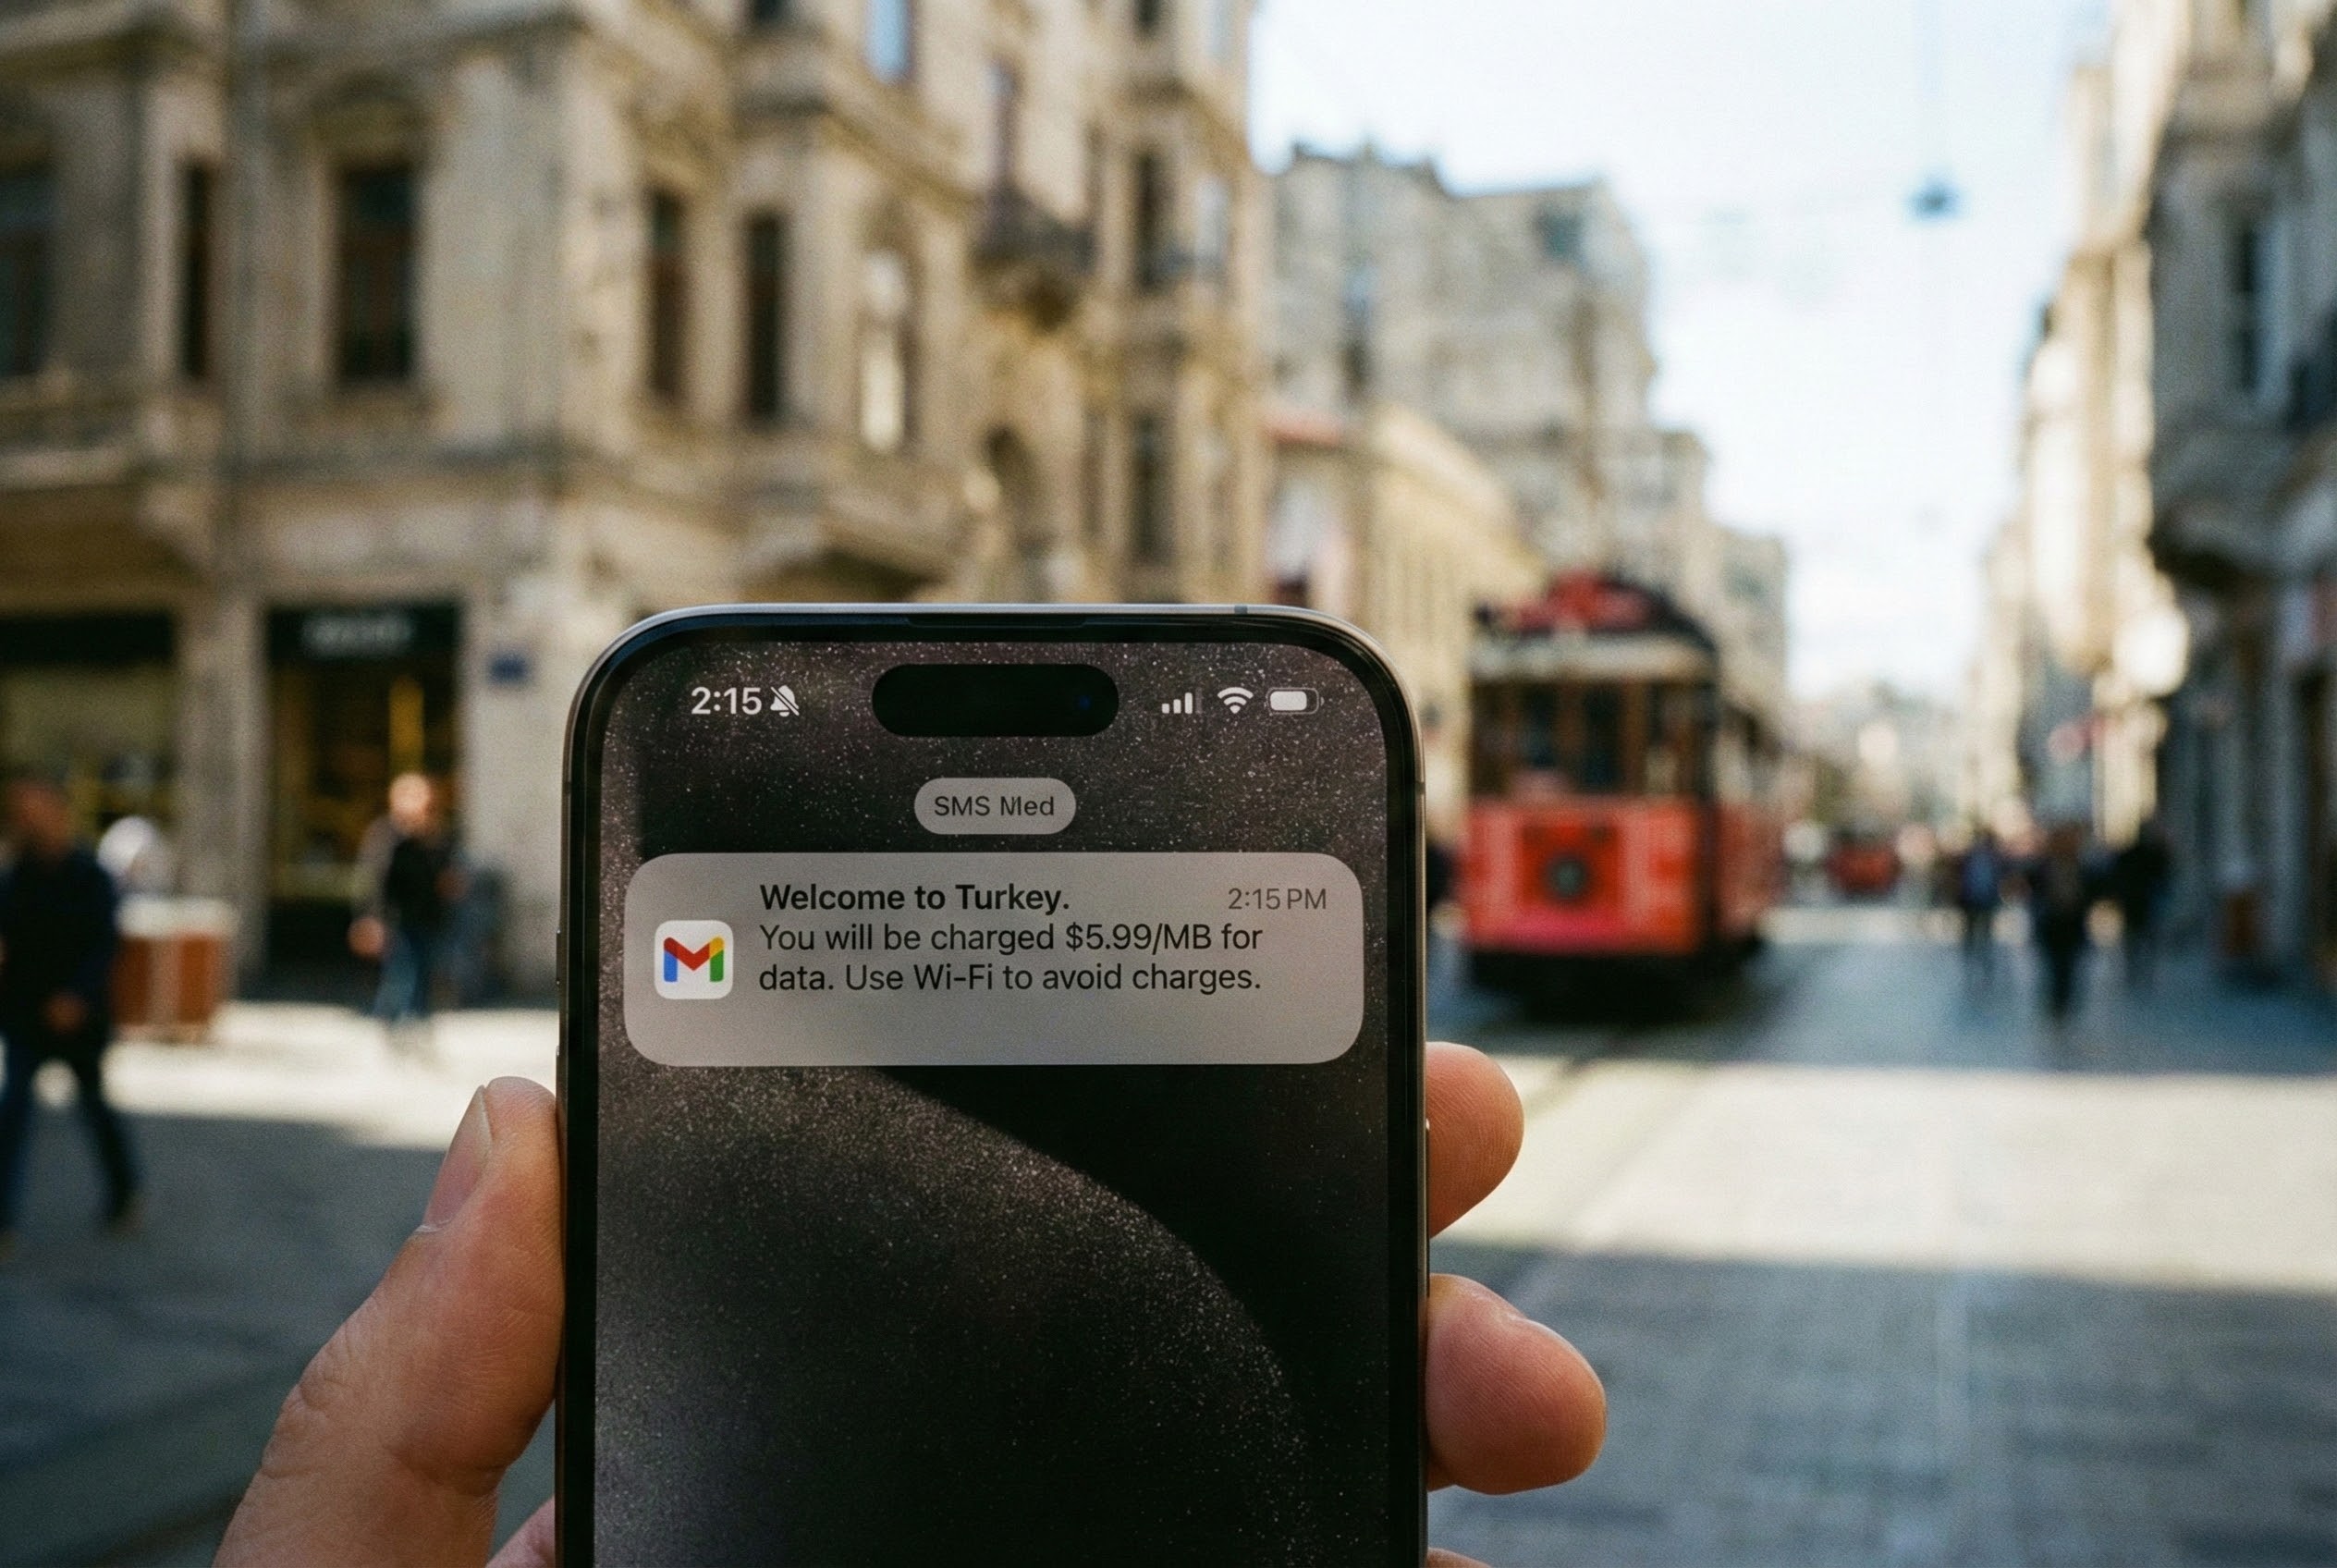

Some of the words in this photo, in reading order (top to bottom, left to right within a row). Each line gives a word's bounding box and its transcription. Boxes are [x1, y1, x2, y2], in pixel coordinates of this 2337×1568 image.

[691, 686, 763, 717] 2:15
[934, 795, 990, 816] SMS
[759, 884, 905, 911] Welcome
[913, 885, 946, 911] to
[955, 884, 1070, 916] Turkey.
[1228, 888, 1281, 911] 2:15
[1287, 888, 1327, 911] PM
[759, 924, 814, 950] You
[825, 923, 873, 950] will
[884, 923, 921, 950] be
[931, 923, 1054, 956] charged
[1066, 922, 1212, 956] $5.99/MB
[1221, 923, 1263, 950] for
[759, 963, 834, 991] data.
[846, 964, 904, 991] Use
[913, 963, 993, 991] Wi-Fi
[1002, 965, 1033, 991] to
[1042, 962, 1121, 991] avoid
[1132, 962, 1260, 997] charges.
